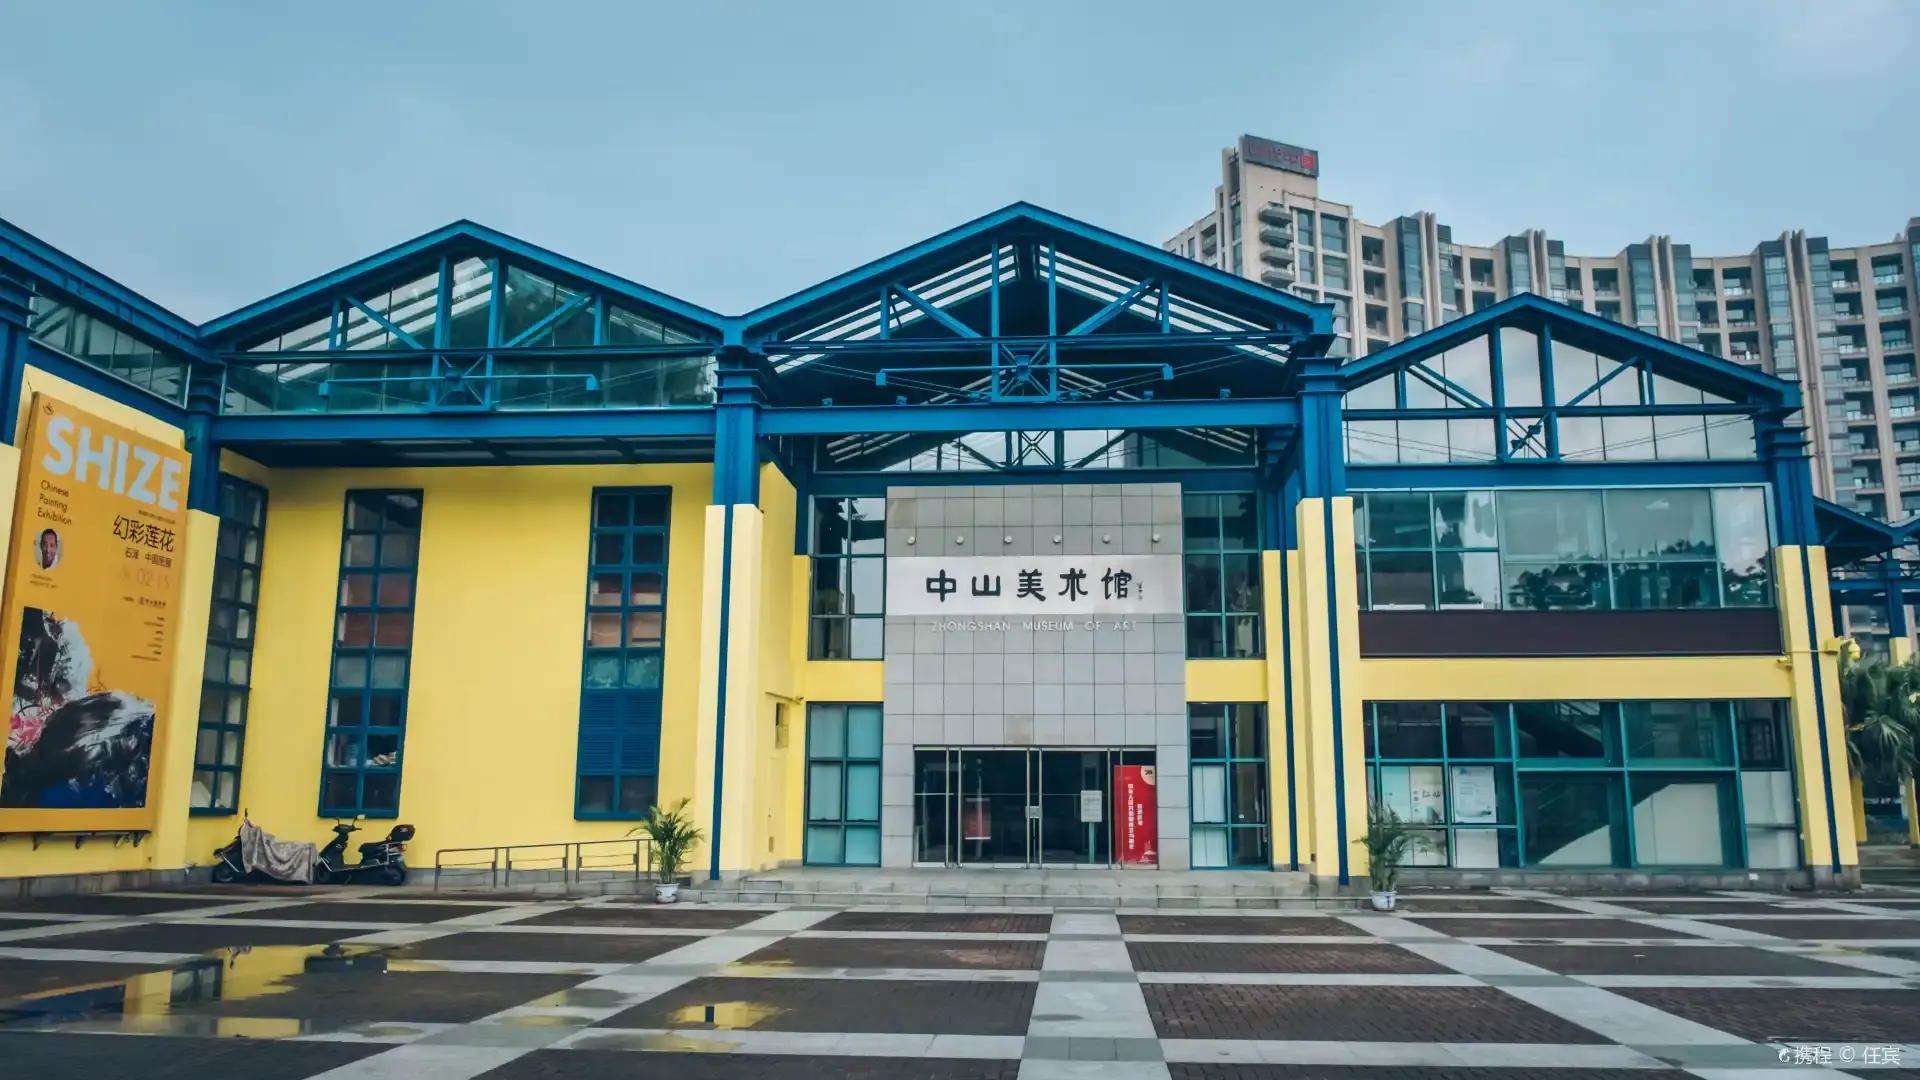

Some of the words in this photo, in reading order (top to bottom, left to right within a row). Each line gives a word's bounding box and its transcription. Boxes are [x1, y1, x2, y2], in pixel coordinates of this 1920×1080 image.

[42, 415, 182, 512] SHIZE
[40, 480, 70, 498] Chinese
[38, 493, 69, 513] Painting
[37, 507, 73, 526] Exhibition
[113, 514, 176, 553] 幻彩莲花
[926, 568, 1133, 602] 中山美术馆
[931, 620, 1011, 632] ZHONGSHAN
[1022, 620, 1074, 632] MUSEUM
[1084, 620, 1102, 631] OF
[1113, 620, 1137, 631] ART
